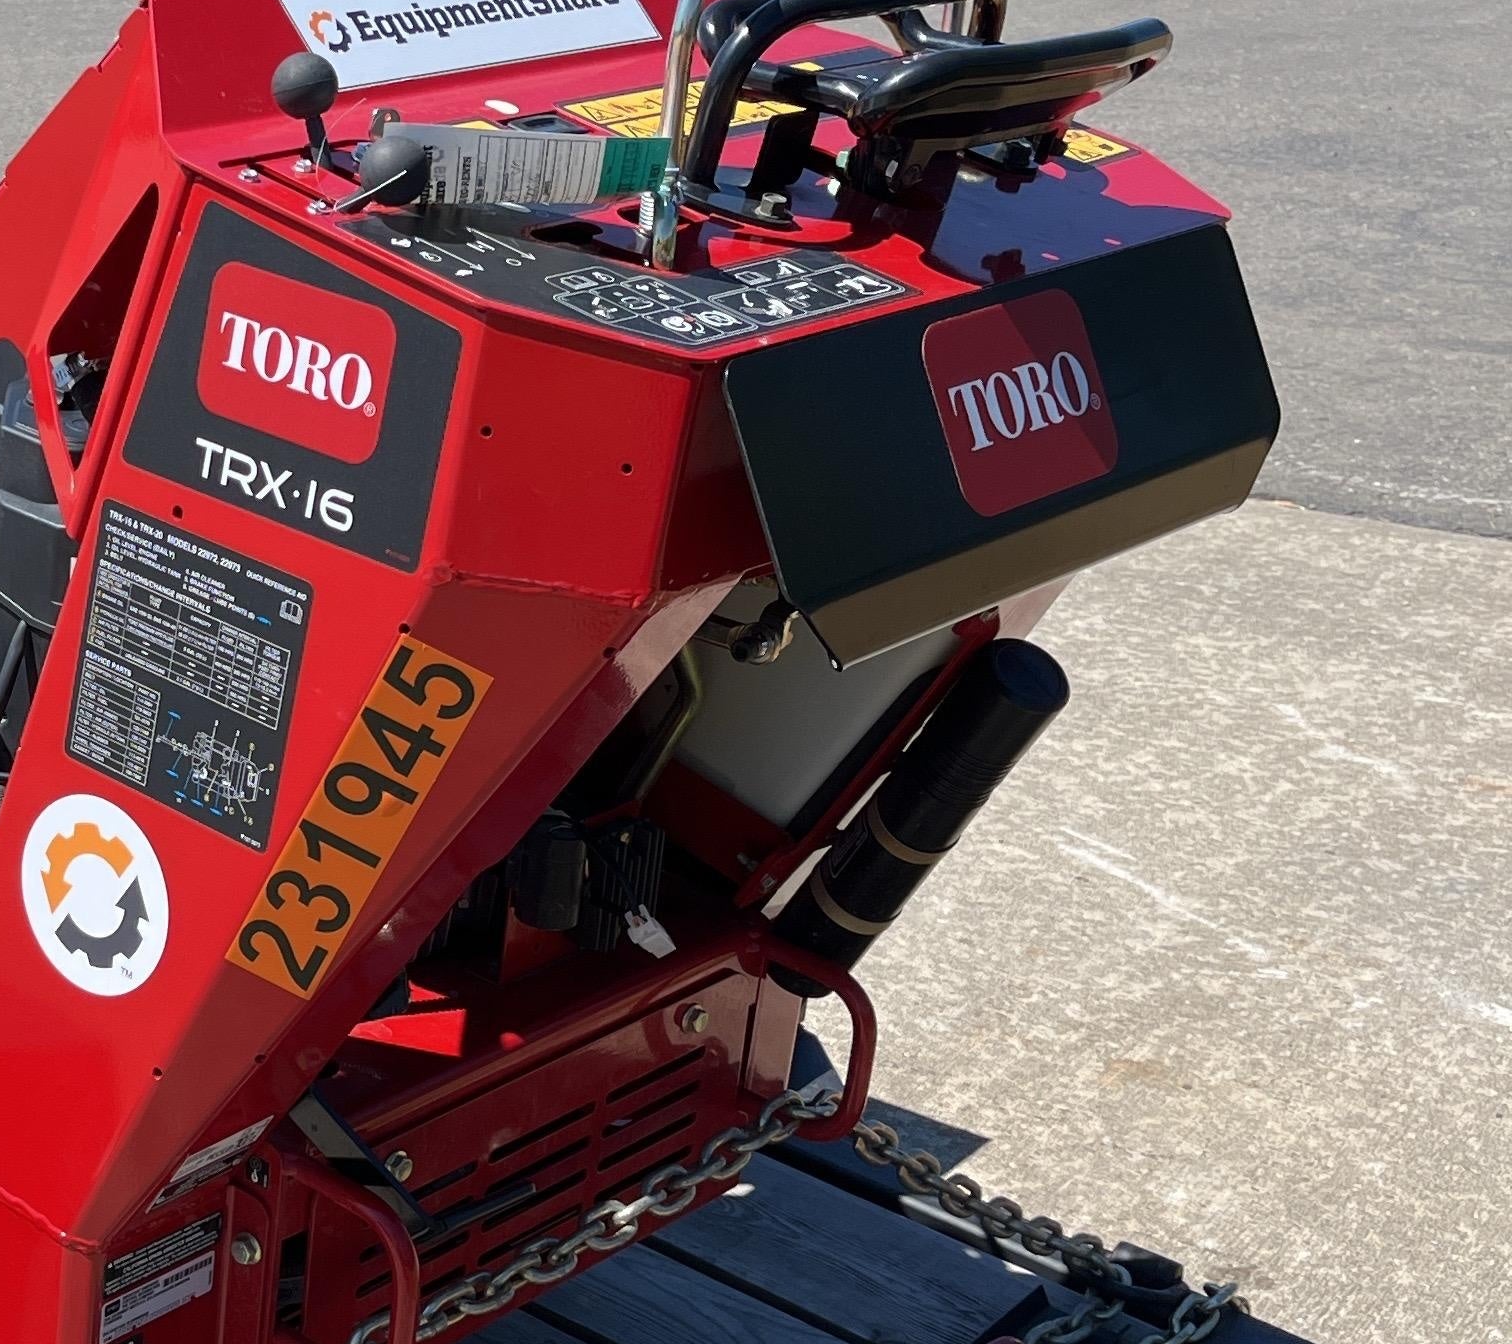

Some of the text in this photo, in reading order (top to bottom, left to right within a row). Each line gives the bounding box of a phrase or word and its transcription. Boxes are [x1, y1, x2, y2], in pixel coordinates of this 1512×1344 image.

[220, 311, 374, 412] TORO
[947, 350, 1088, 453] TORO
[238, 661, 477, 992] 231945
